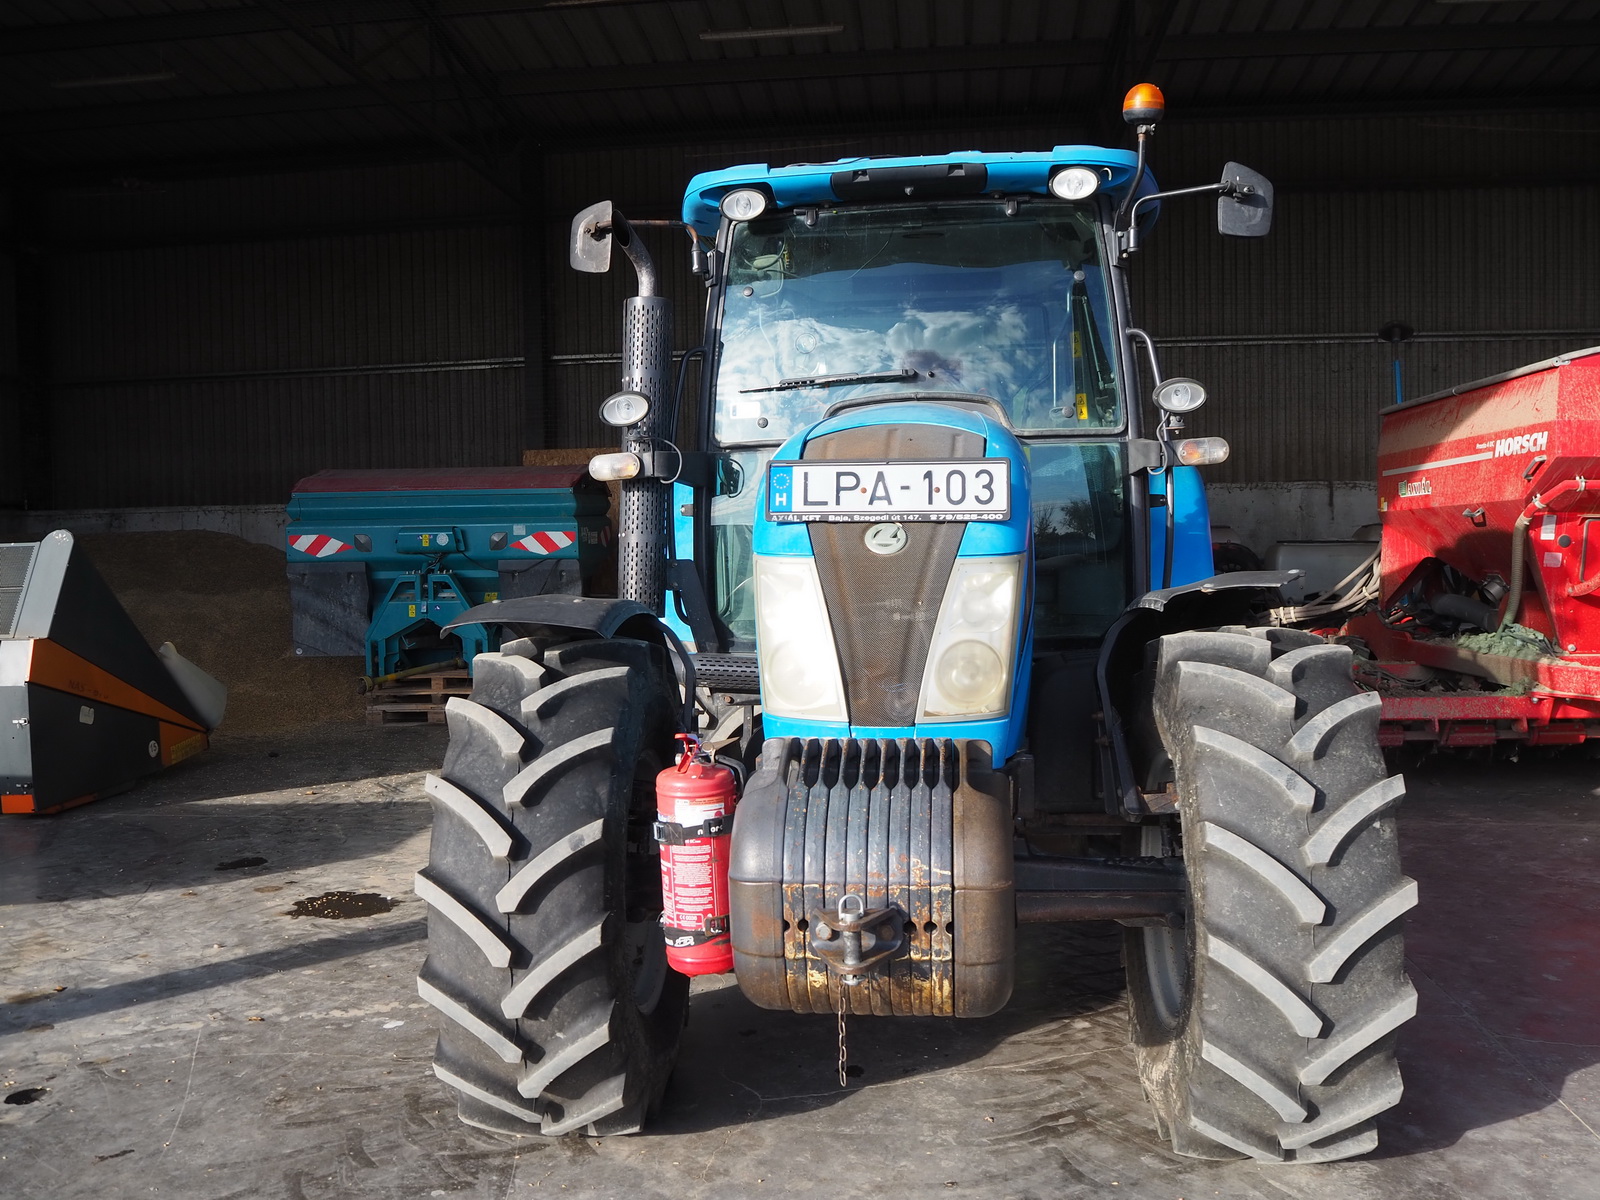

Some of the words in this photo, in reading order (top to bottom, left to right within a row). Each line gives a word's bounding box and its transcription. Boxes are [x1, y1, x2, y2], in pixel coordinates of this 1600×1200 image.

[1494, 431, 1549, 458] HORSCH
[803, 468, 995, 506] LPA-103
[775, 492, 787, 506] H
[802, 514, 821, 522] KFT
[828, 514, 851, 522] Baja,
[853, 514, 889, 522] Szegedi
